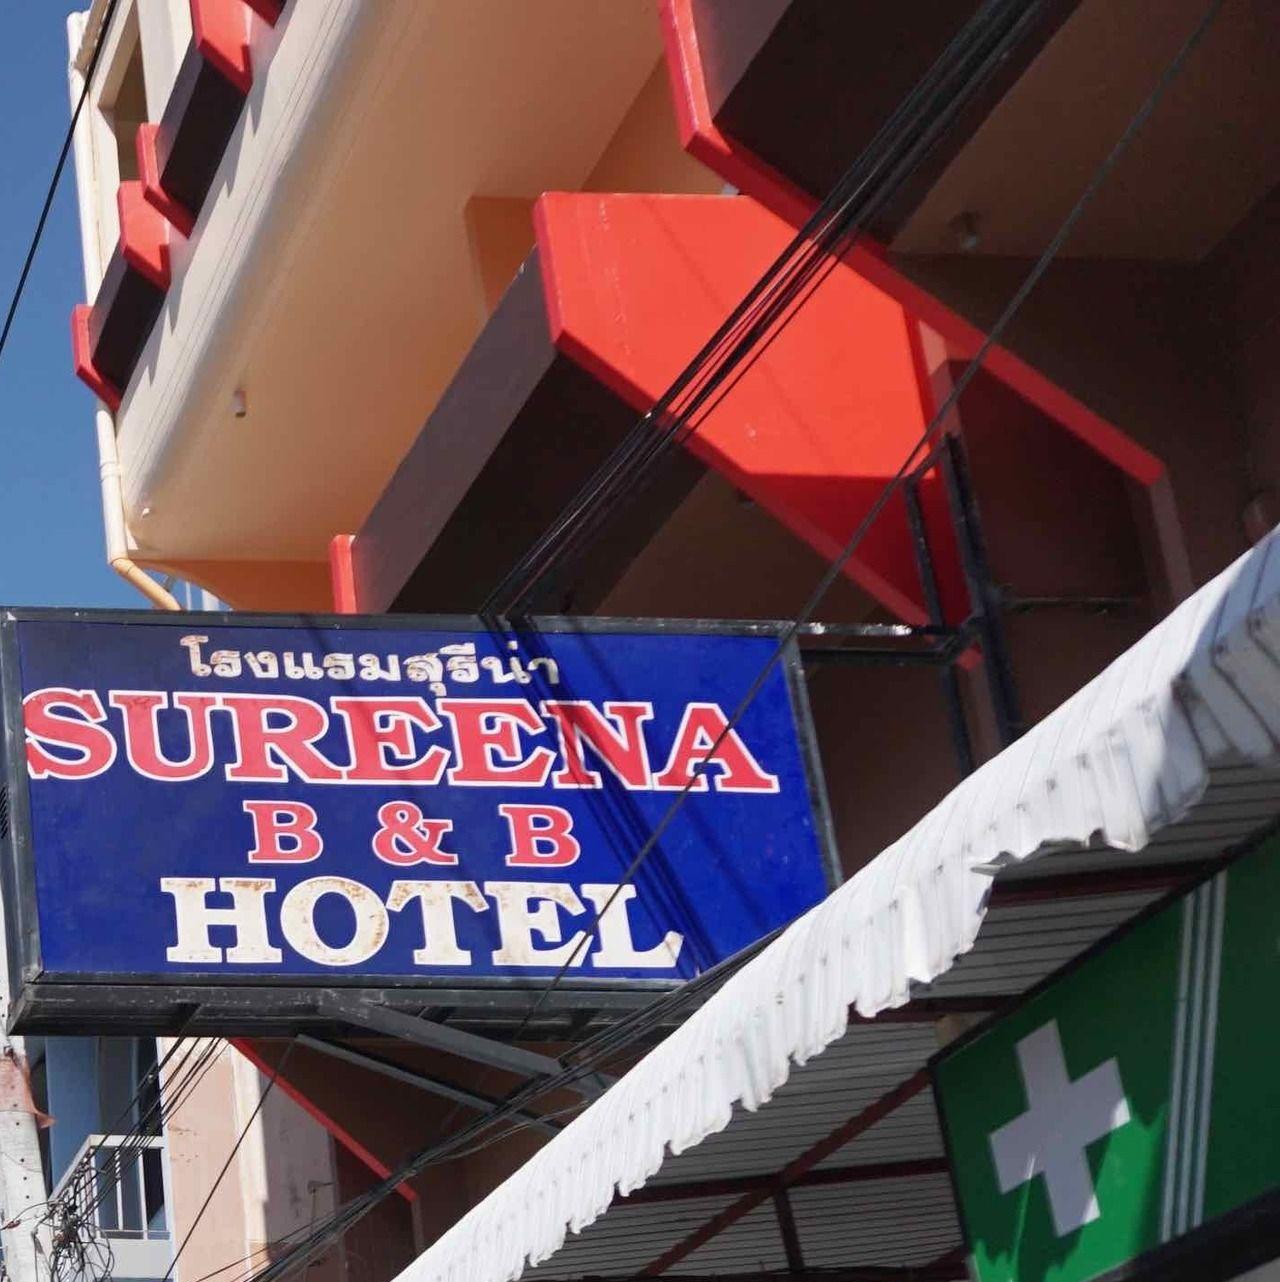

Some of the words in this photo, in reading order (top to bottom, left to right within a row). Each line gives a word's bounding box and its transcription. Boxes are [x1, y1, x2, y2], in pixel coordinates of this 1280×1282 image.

[22, 688, 780, 793] SUREENA
[243, 799, 322, 865] B
[371, 800, 458, 867] &
[498, 804, 581, 868] B
[160, 876, 684, 970] HOTEL
